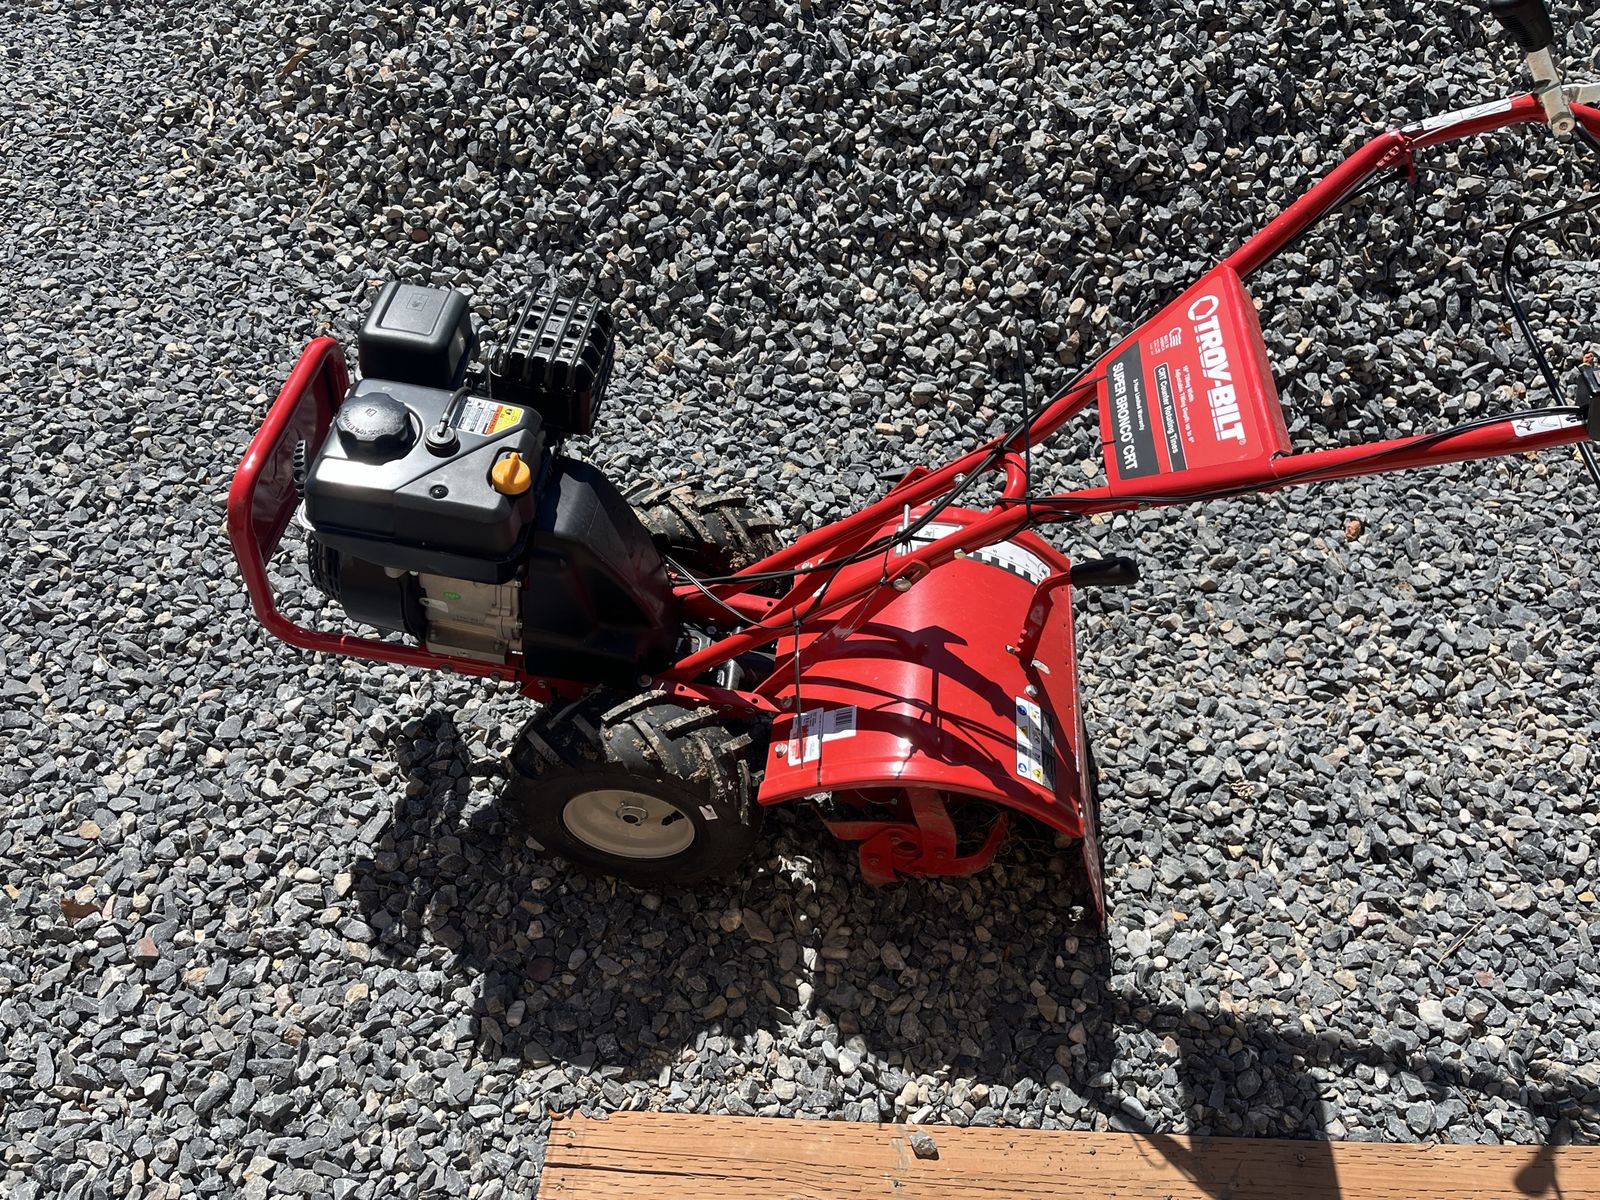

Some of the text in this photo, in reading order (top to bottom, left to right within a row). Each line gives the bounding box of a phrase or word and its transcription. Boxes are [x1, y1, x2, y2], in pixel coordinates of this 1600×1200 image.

[1112, 362, 1137, 470] SUPER BRONCO CRT
[1158, 367, 1179, 453] CRT Counter Rotating Tines
[1194, 315, 1245, 441] TROY-BILT
